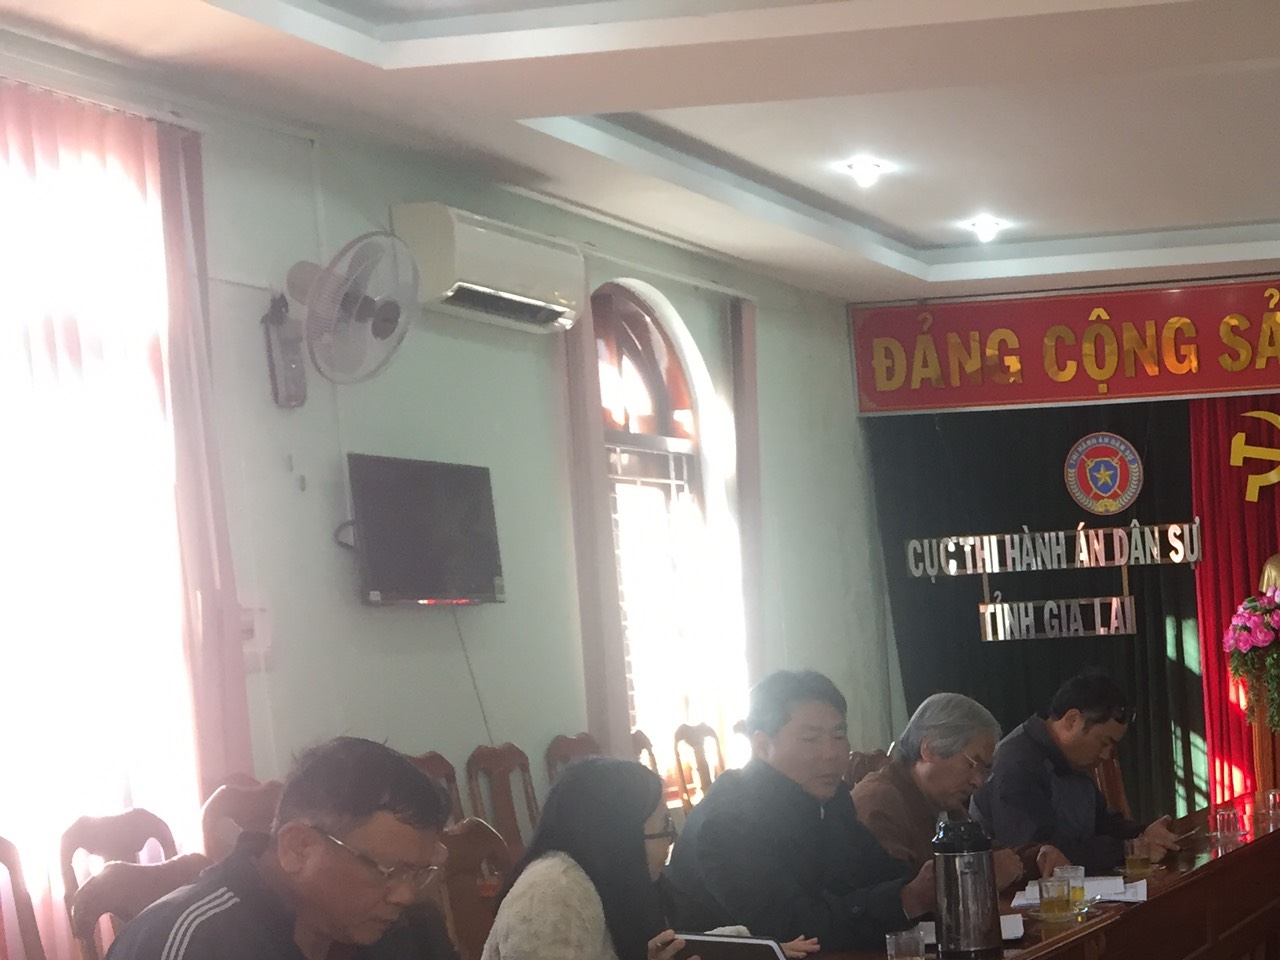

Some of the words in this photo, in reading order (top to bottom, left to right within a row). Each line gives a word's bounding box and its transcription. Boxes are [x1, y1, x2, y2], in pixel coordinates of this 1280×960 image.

[872, 311, 1022, 391] ĐẢNG
[1043, 308, 1199, 393] CỘNG
[908, 537, 957, 584] CỤC
[952, 535, 1000, 575] THI
[1004, 525, 1067, 572] HÀNH
[1074, 521, 1106, 568] ÁN
[1113, 518, 1162, 567] DÂN
[1167, 516, 1201, 570] SỰ
[980, 590, 1036, 641] TỈNH
[1043, 598, 1085, 638] GIA
[1094, 596, 1135, 636] LAI
